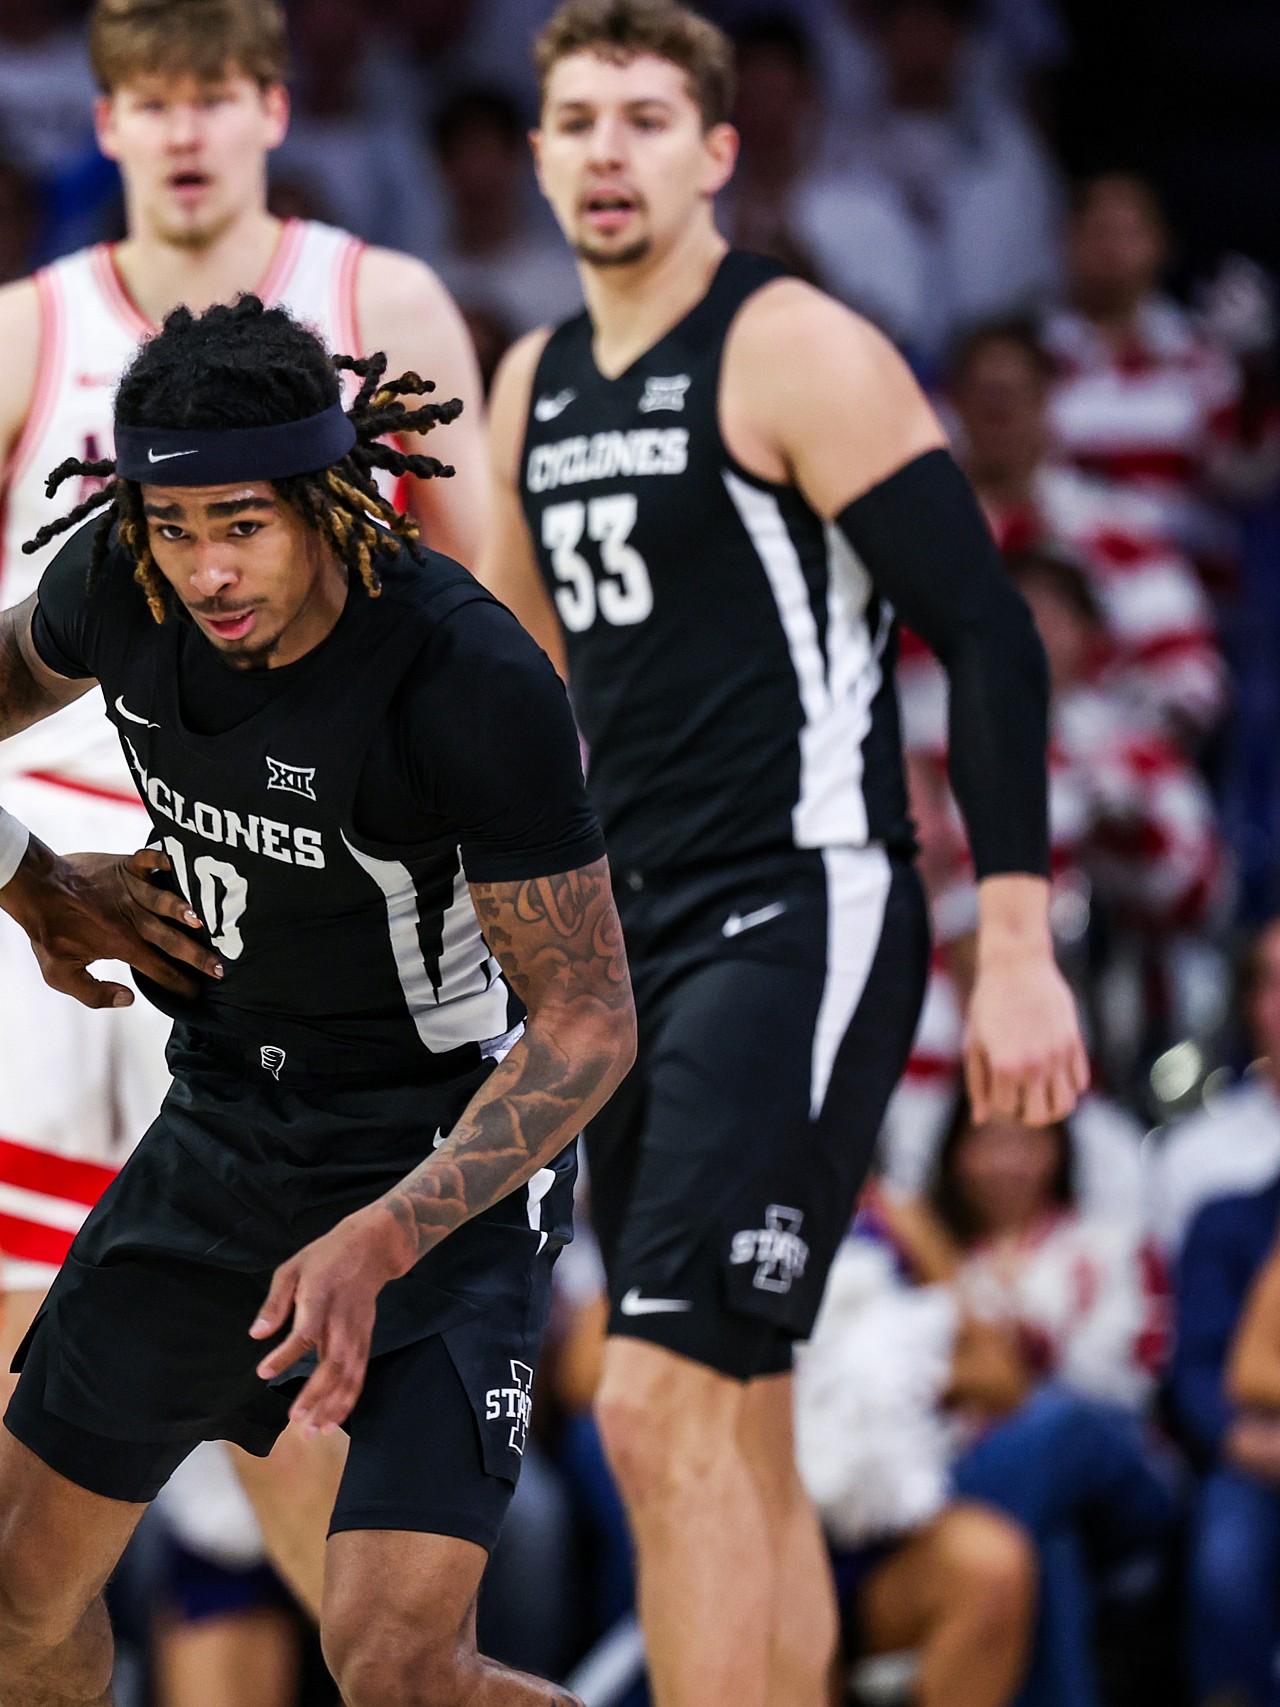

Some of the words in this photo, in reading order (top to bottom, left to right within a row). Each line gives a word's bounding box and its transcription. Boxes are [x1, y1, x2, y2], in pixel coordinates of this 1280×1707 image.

[526, 427, 689, 493] CYCLONES
[540, 492, 654, 633] 33
[268, 759, 314, 798] XII
[163, 836, 249, 961] 10
[485, 1388, 533, 1429] STAT
